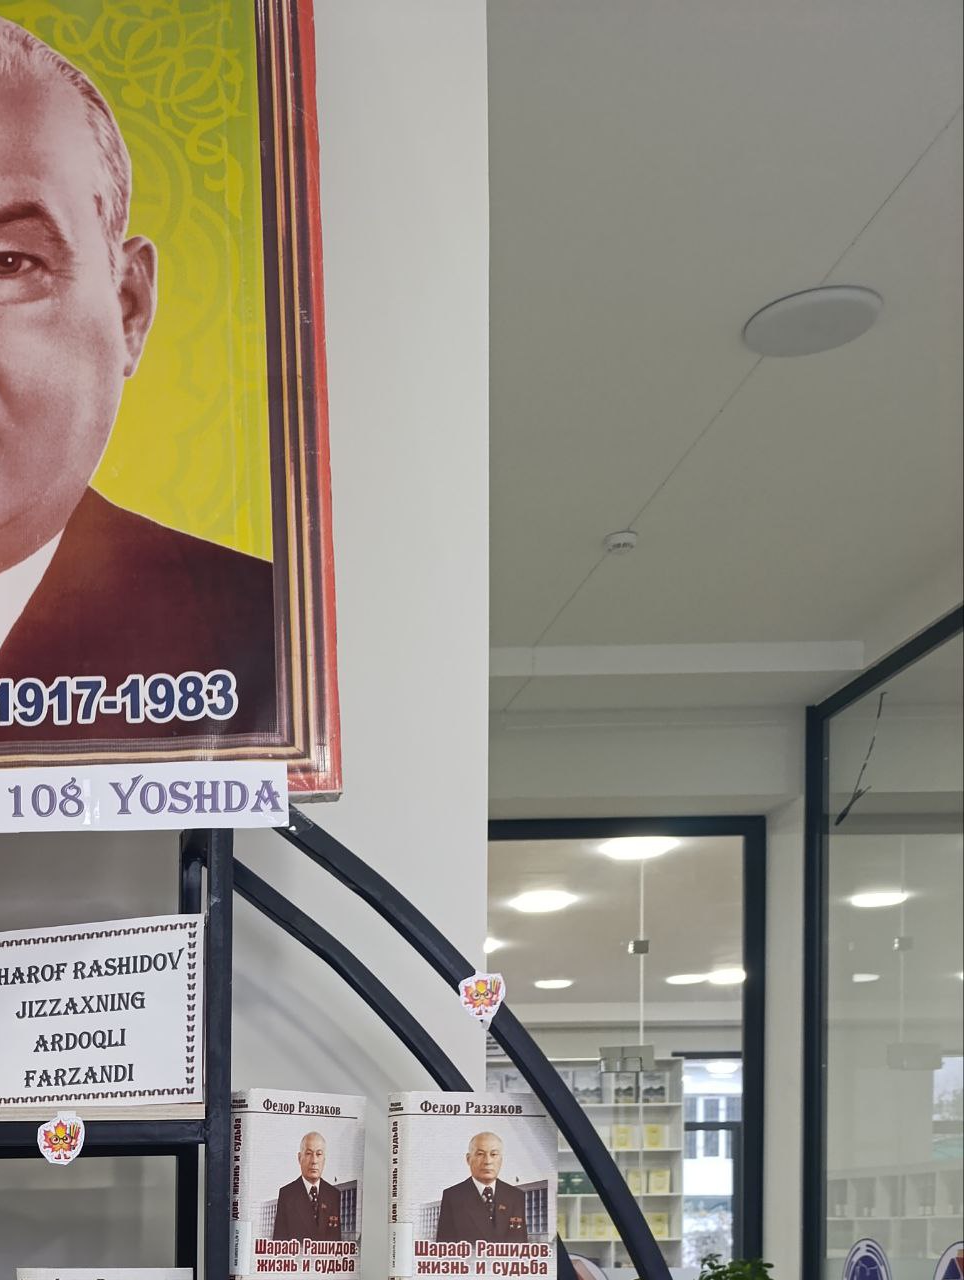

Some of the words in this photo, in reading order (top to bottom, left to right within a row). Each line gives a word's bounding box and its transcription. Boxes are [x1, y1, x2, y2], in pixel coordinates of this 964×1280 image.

[9, 777, 85, 818] 108
[110, 775, 282, 815] YOSHDA
[73, 948, 184, 980] RASHIDOV
[16, 992, 145, 1019] JIZZAXNING
[34, 1029, 125, 1052] ARDOQLI
[24, 1064, 134, 1088] FARZANDI
[263, 1099, 294, 1114] Федор
[298, 1100, 340, 1116] Раззаков
[420, 1101, 460, 1115] Федор
[465, 1101, 522, 1115] Раззаков
[255, 1240, 300, 1255] Шараф
[415, 1242, 470, 1258] Шараф
[257, 1258, 298, 1272] жизнь
[303, 1259, 310, 1272] и
[314, 1258, 355, 1274] судьба
[418, 1261, 469, 1276] жизнь
[476, 1261, 485, 1274] и
[492, 1261, 547, 1276] судьба
